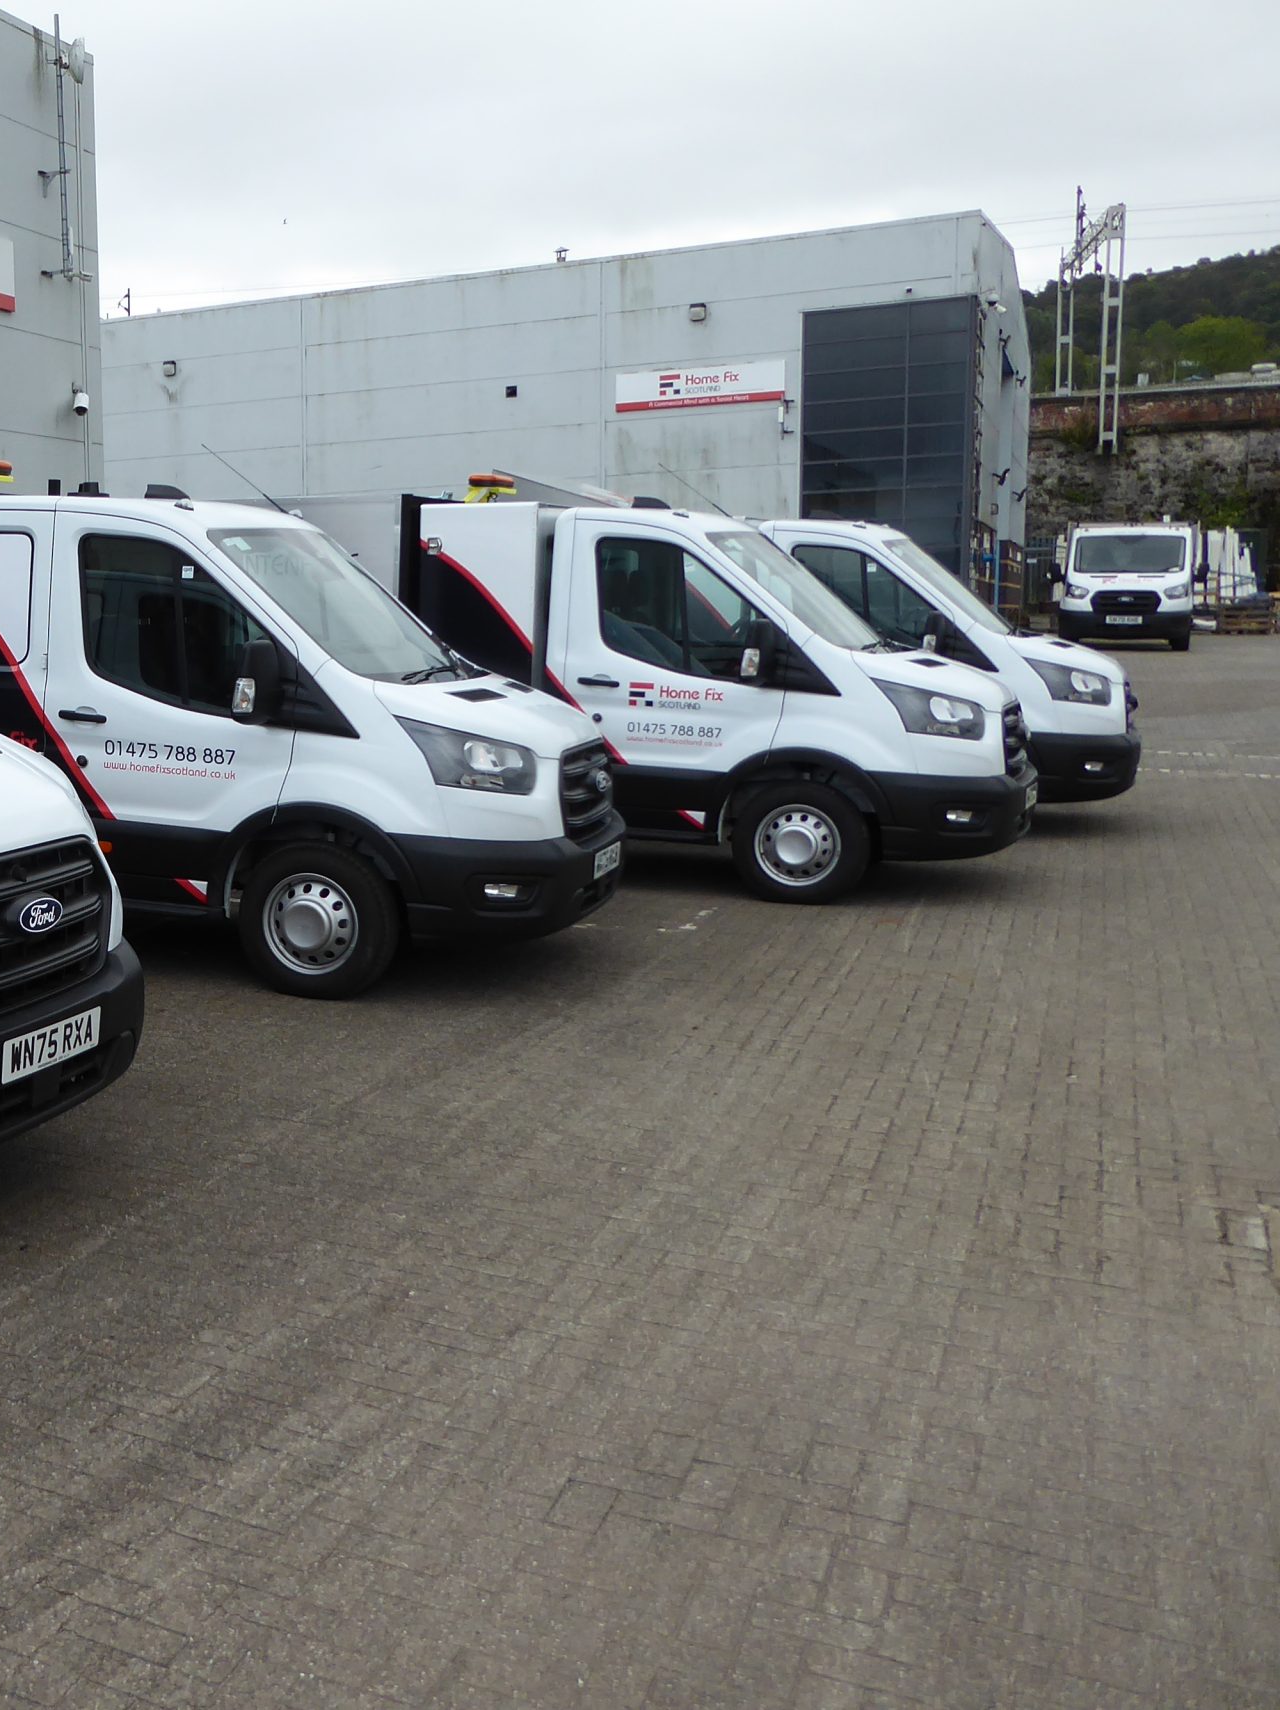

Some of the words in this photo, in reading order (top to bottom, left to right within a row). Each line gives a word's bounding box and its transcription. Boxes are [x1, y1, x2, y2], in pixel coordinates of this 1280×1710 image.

[686, 374, 719, 385] Home
[723, 371, 739, 382] Fix
[685, 385, 721, 394] SCOTLAND
[660, 685, 700, 700] Home
[704, 688, 724, 701] Fix
[658, 700, 701, 710] SCOTLAND
[627, 722, 666, 735] 01475
[671, 724, 694, 737] 788
[698, 726, 722, 738] 887
[104, 739, 158, 759] 01475
[163, 744, 197, 762] 788
[202, 747, 236, 765] 887
[103, 761, 236, 780] www.homefixscotland.co.uk
[30, 903, 56, 928] Ford
[11, 1027, 59, 1074] WN75
[62, 1014, 93, 1054] RXA
